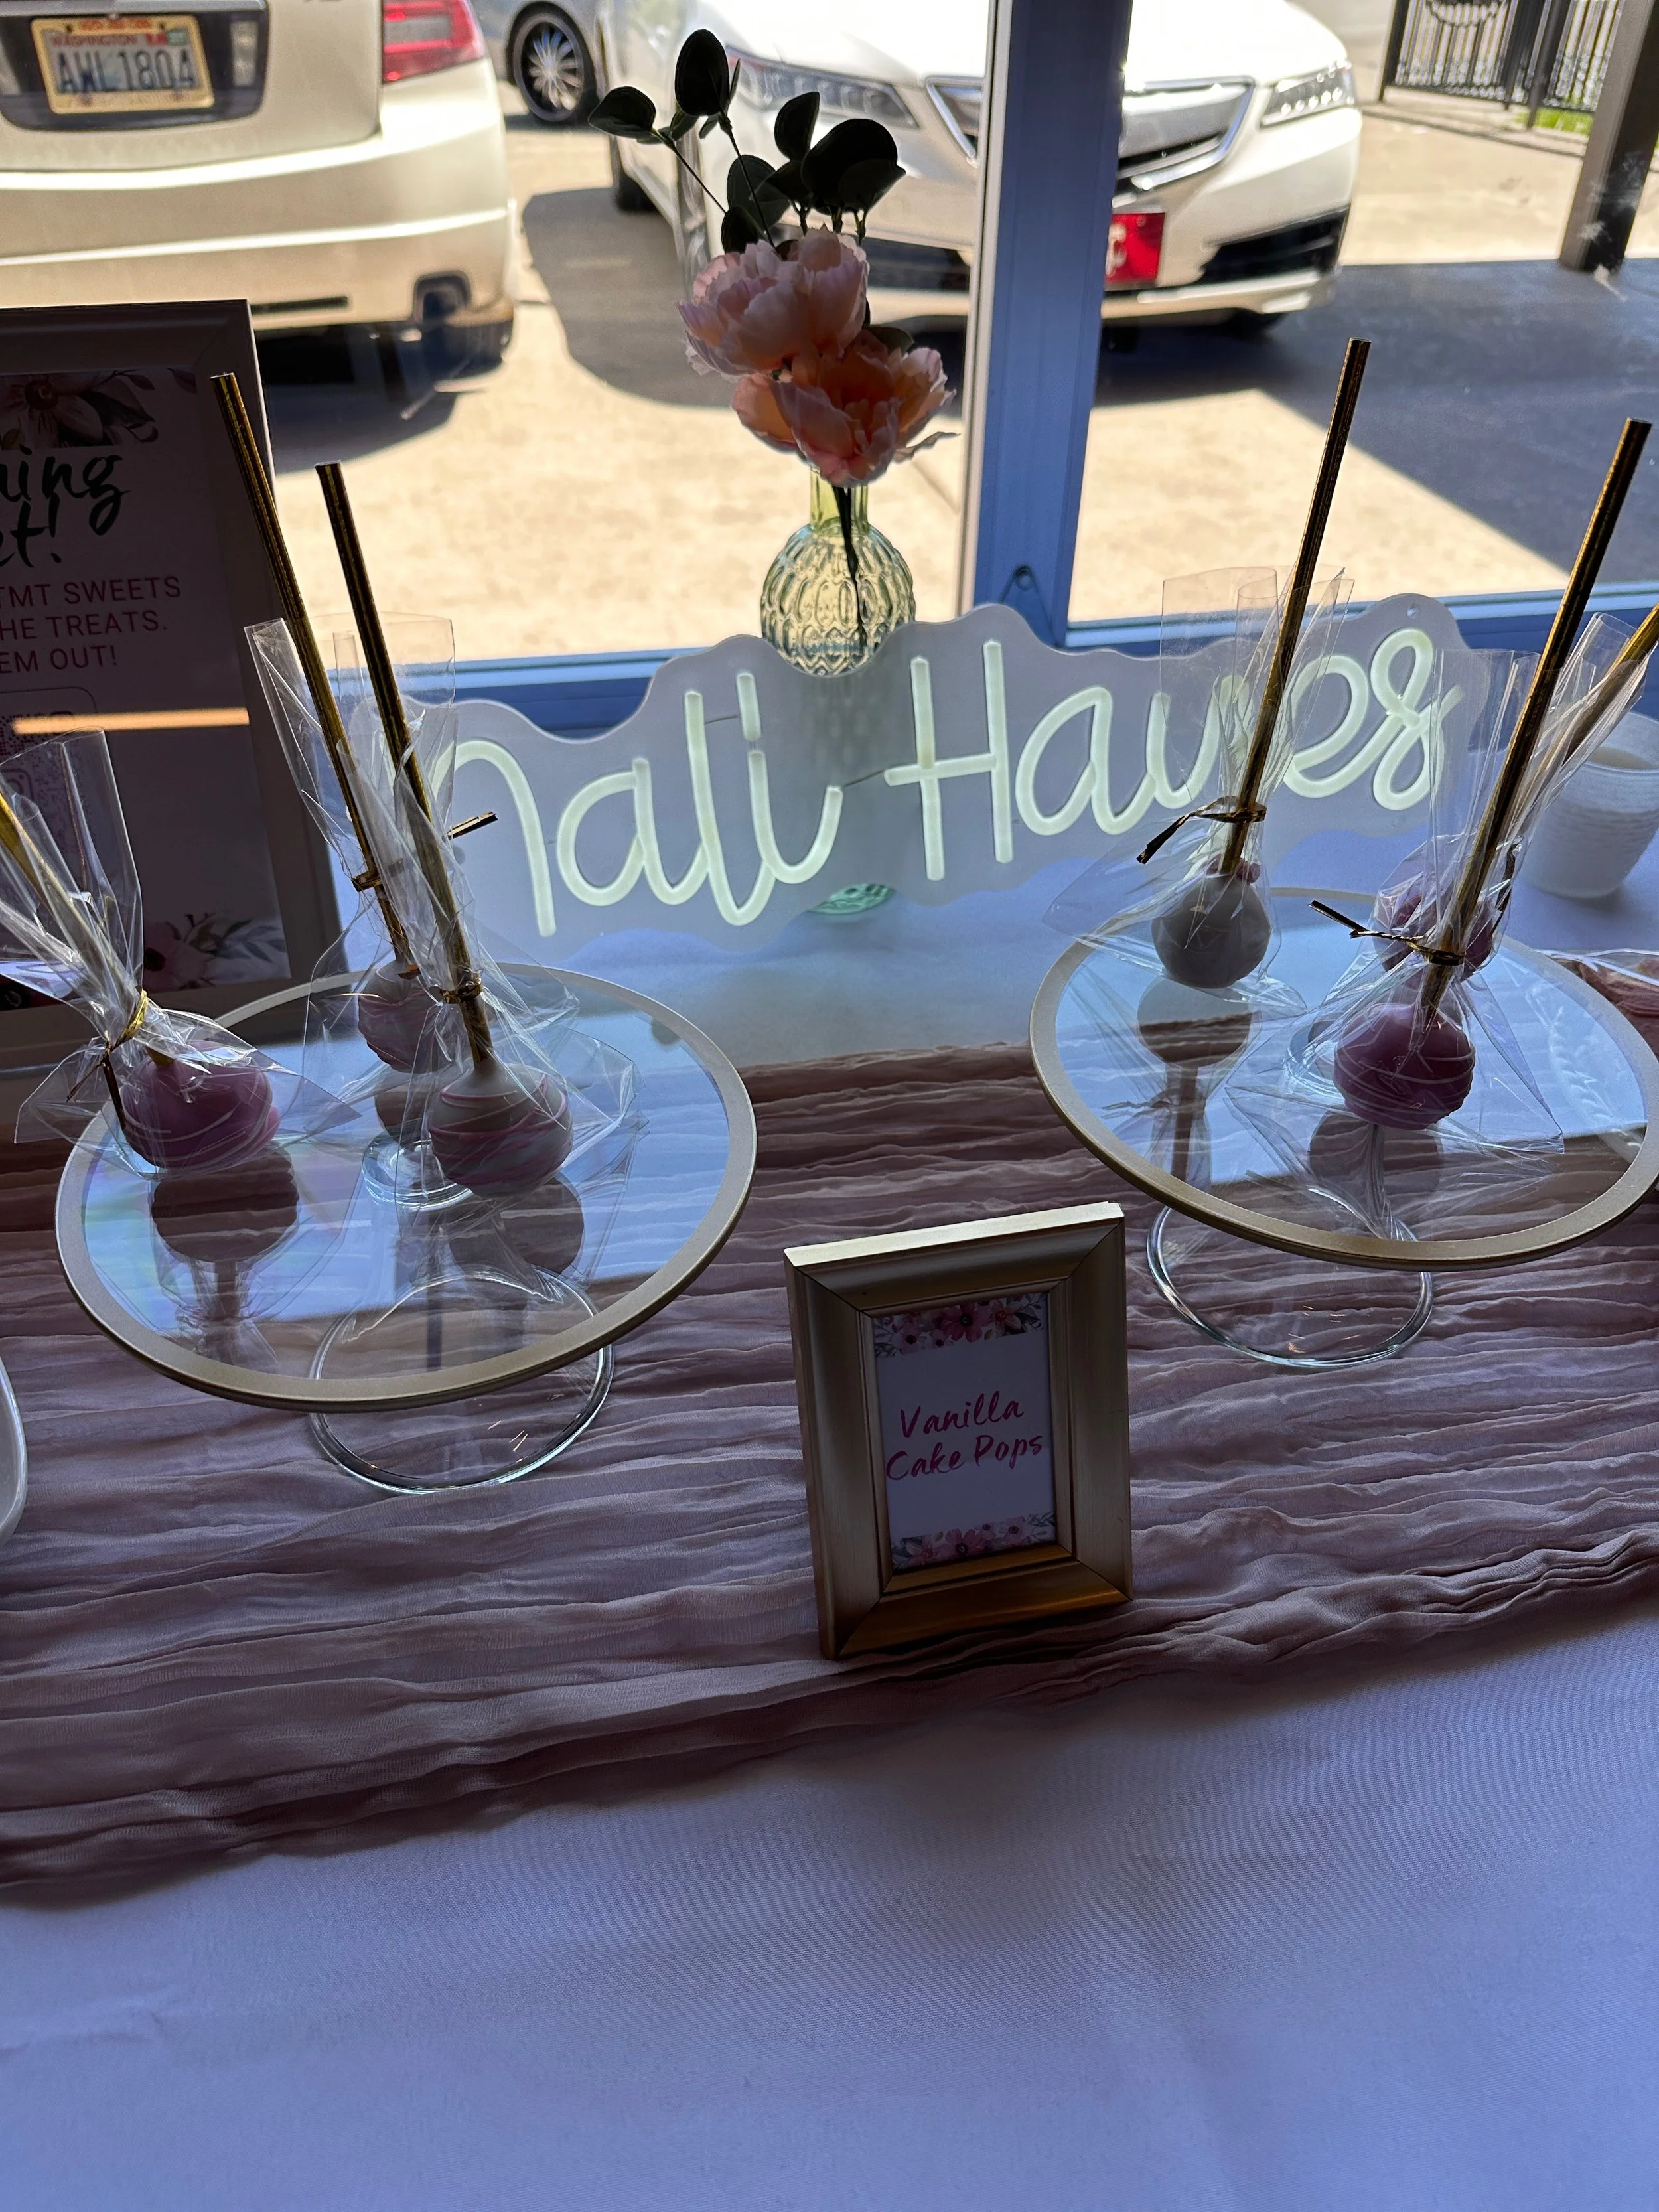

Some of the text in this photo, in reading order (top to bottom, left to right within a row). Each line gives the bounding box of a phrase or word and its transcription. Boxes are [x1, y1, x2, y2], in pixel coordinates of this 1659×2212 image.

[63, 576, 181, 605] SWEETS
[46, 609, 168, 638] TREATS.
[50, 645, 117, 670] OUT!
[900, 1390, 1025, 1438] Vanilla
[885, 1434, 1044, 1481] Cake Pops
